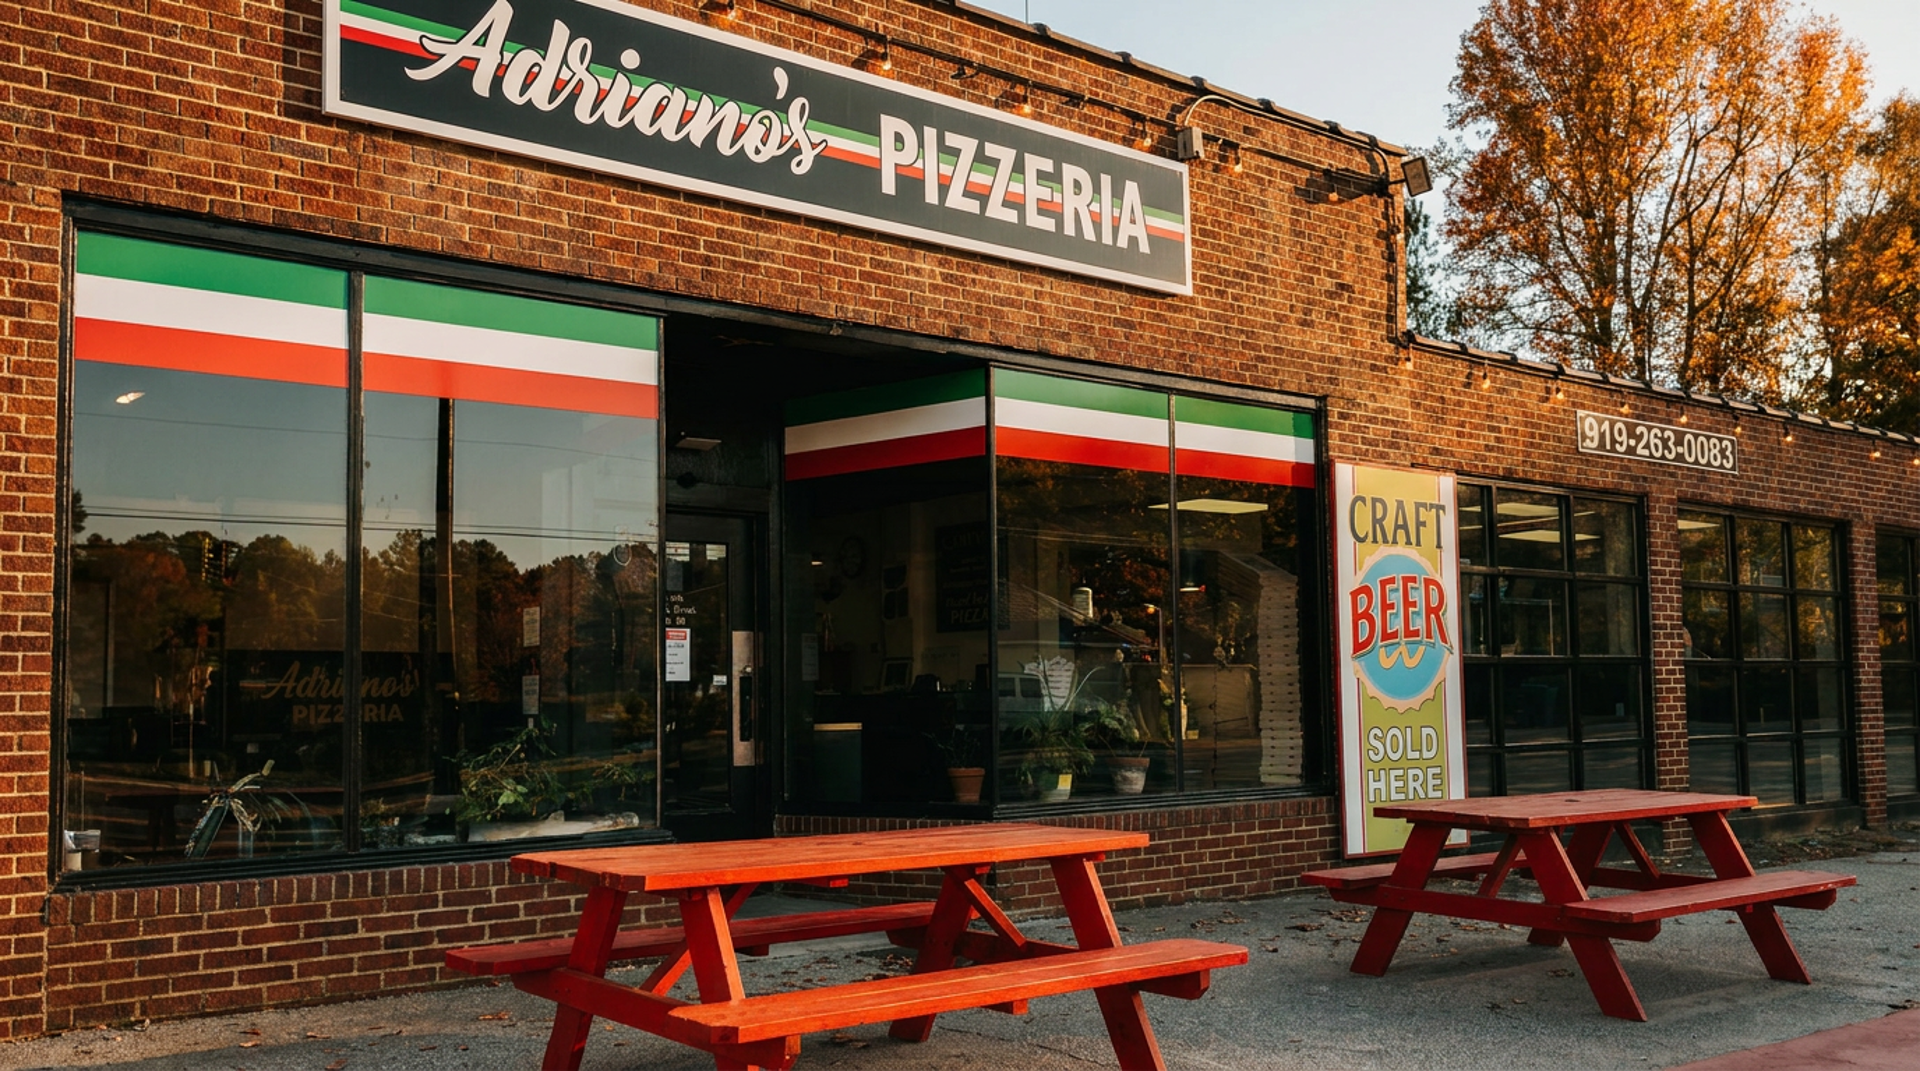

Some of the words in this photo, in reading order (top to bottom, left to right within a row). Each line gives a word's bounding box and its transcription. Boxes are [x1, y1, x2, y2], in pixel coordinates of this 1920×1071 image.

[404, 0, 827, 175] Adriano's
[880, 114, 1150, 254] PIZZERIA
[1583, 416, 1734, 469] 919-263-0083
[1349, 494, 1446, 549] CRAFT
[1348, 574, 1453, 660] BEER
[292, 703, 404, 725] PIZZRIA
[1367, 725, 1438, 762] SOLD
[1367, 766, 1444, 802] HERE
